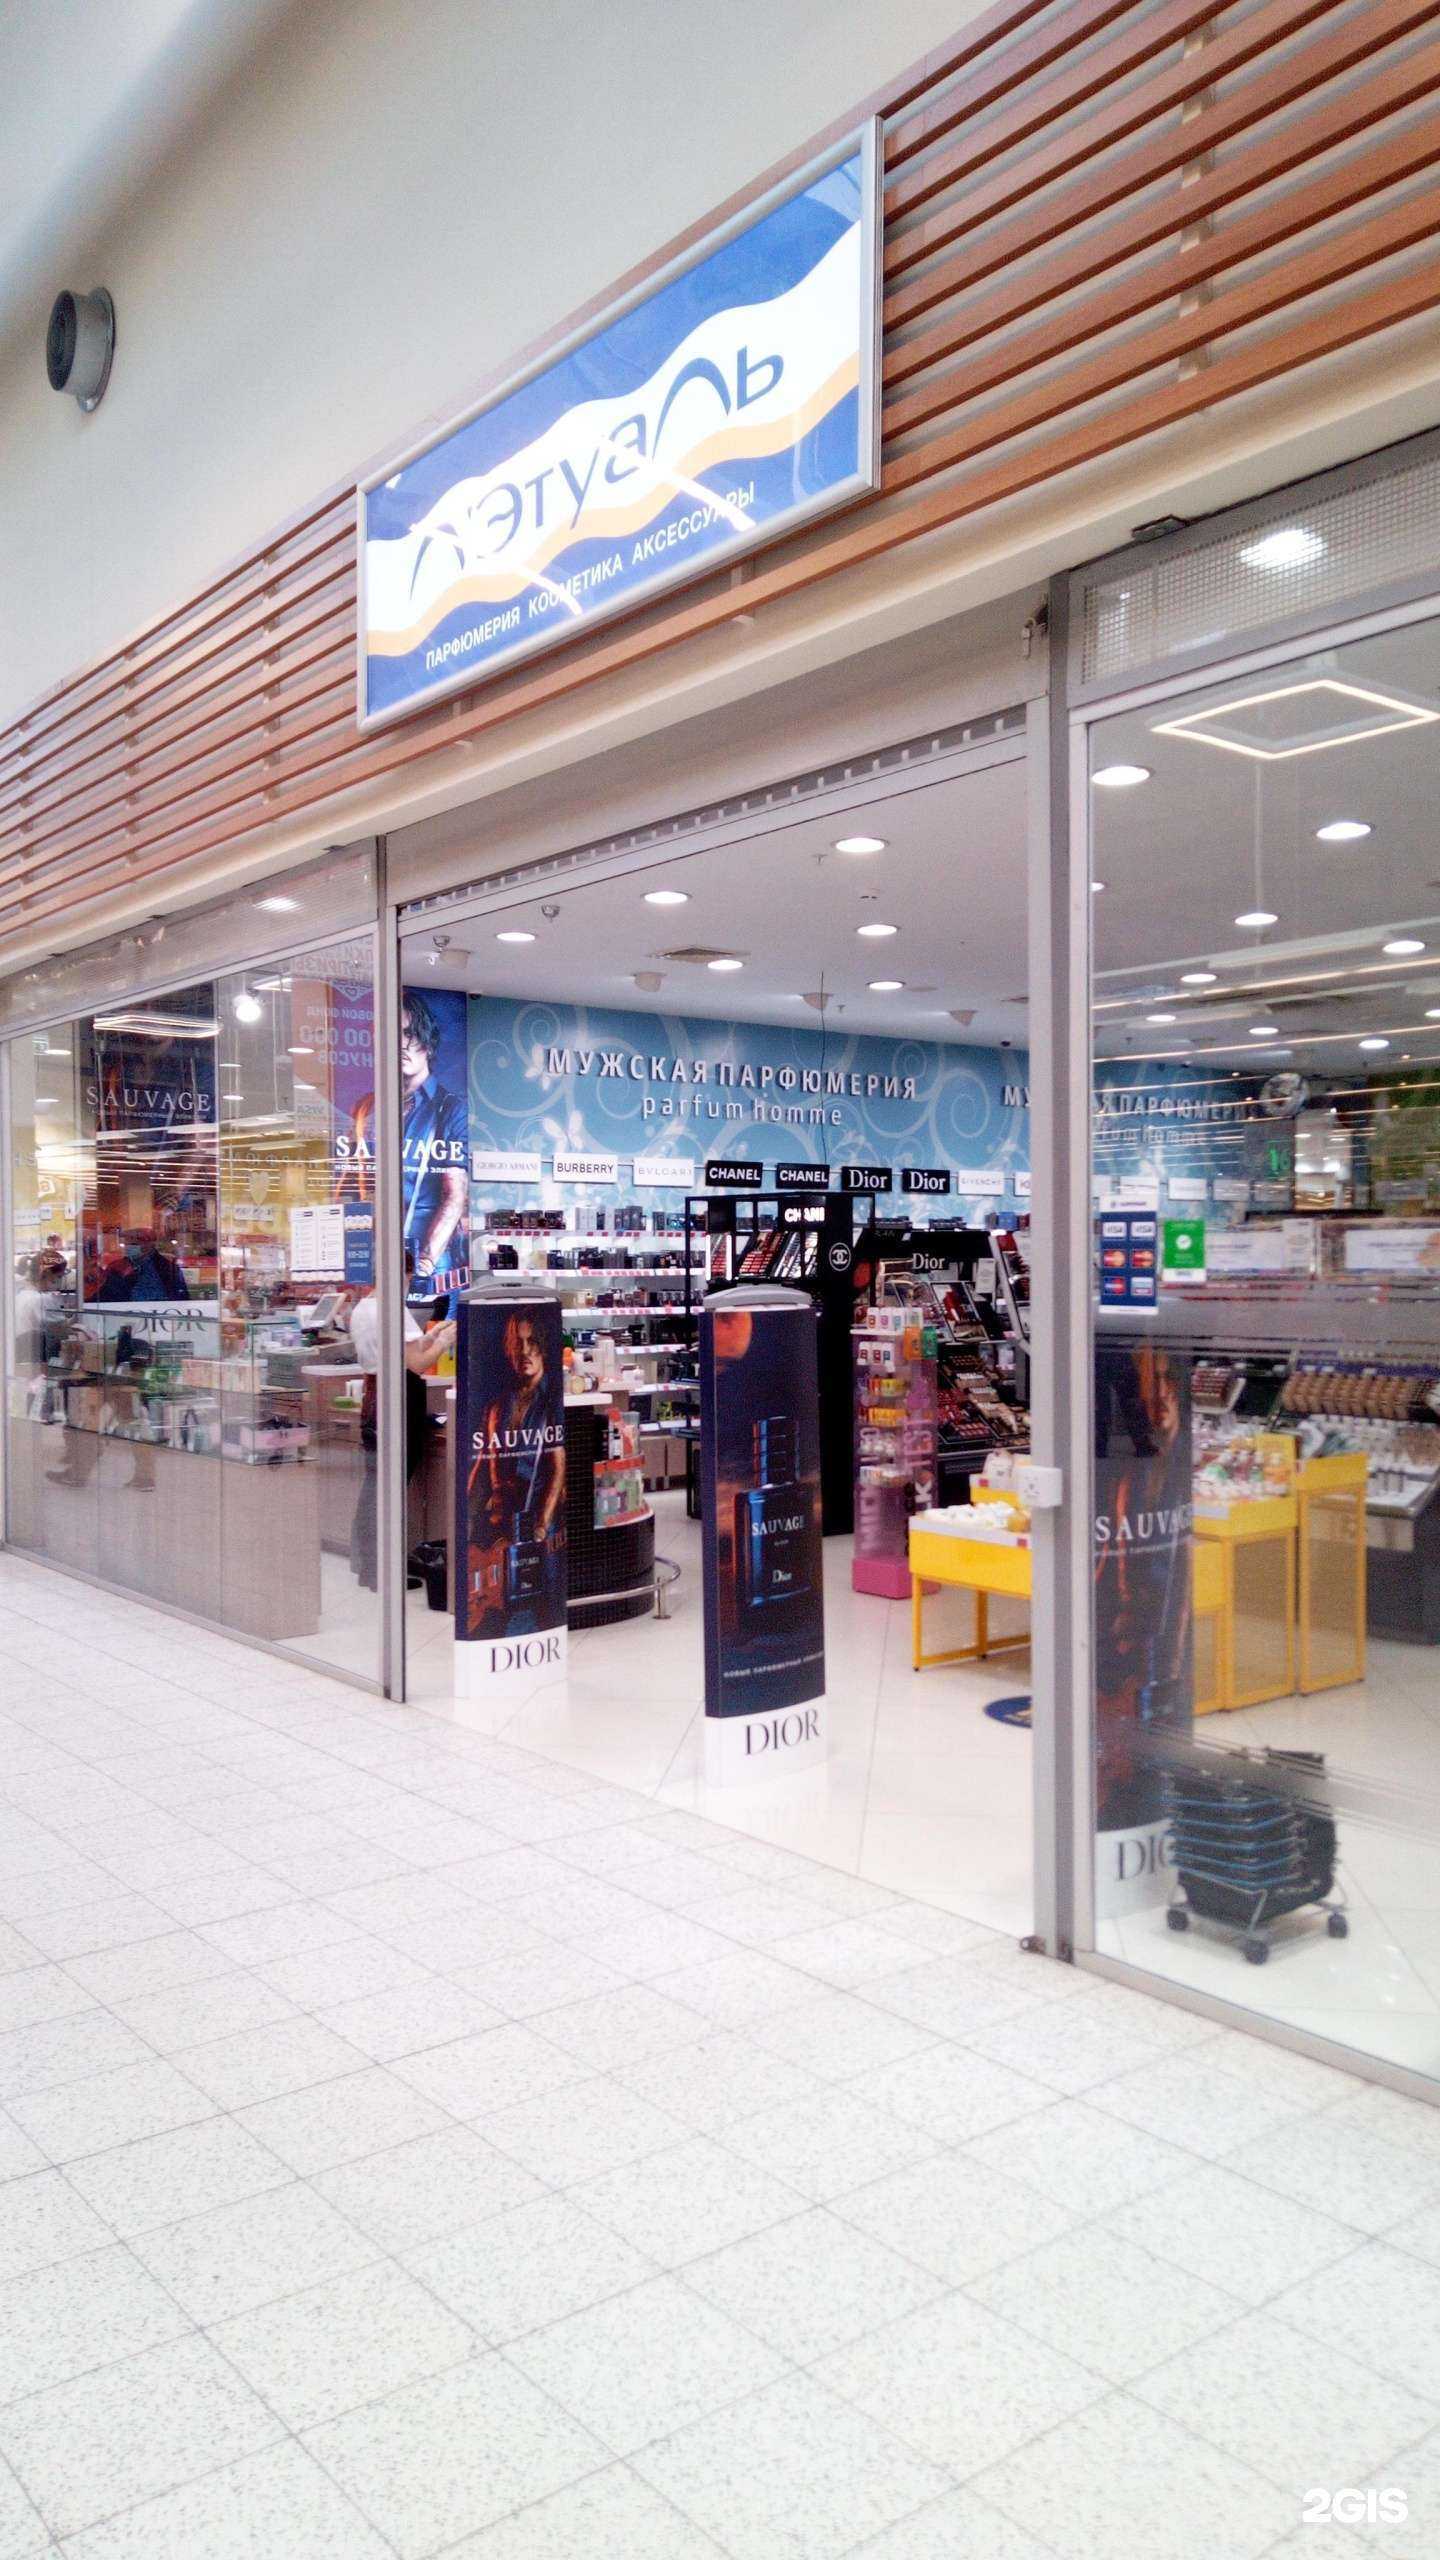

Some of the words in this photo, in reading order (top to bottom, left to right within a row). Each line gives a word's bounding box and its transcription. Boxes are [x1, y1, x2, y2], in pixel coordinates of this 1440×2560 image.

[426, 606, 520, 670] ПАРФЮМЕРИЯ
[548, 1048, 709, 1084] МУЖСКАЯ
[717, 1062, 917, 1099] ПАРФЮМЕРИЯ
[87, 1086, 211, 1112] SAUVAGE
[642, 1093, 744, 1121] parfum
[753, 1098, 843, 1126] homme
[336, 1135, 465, 1162] SAVAGE
[556, 1162, 614, 1175] BURBERRY
[708, 1167, 761, 1182] CHANEL
[779, 1169, 829, 1184] CHANEL
[849, 1168, 888, 1189] Dior
[910, 1171, 947, 1191] Dior
[912, 1252, 946, 1271] Dior
[472, 1425, 564, 1450] SAUVAGE
[490, 1636, 561, 1673] DIOR
[745, 1708, 820, 1756] DIOR
